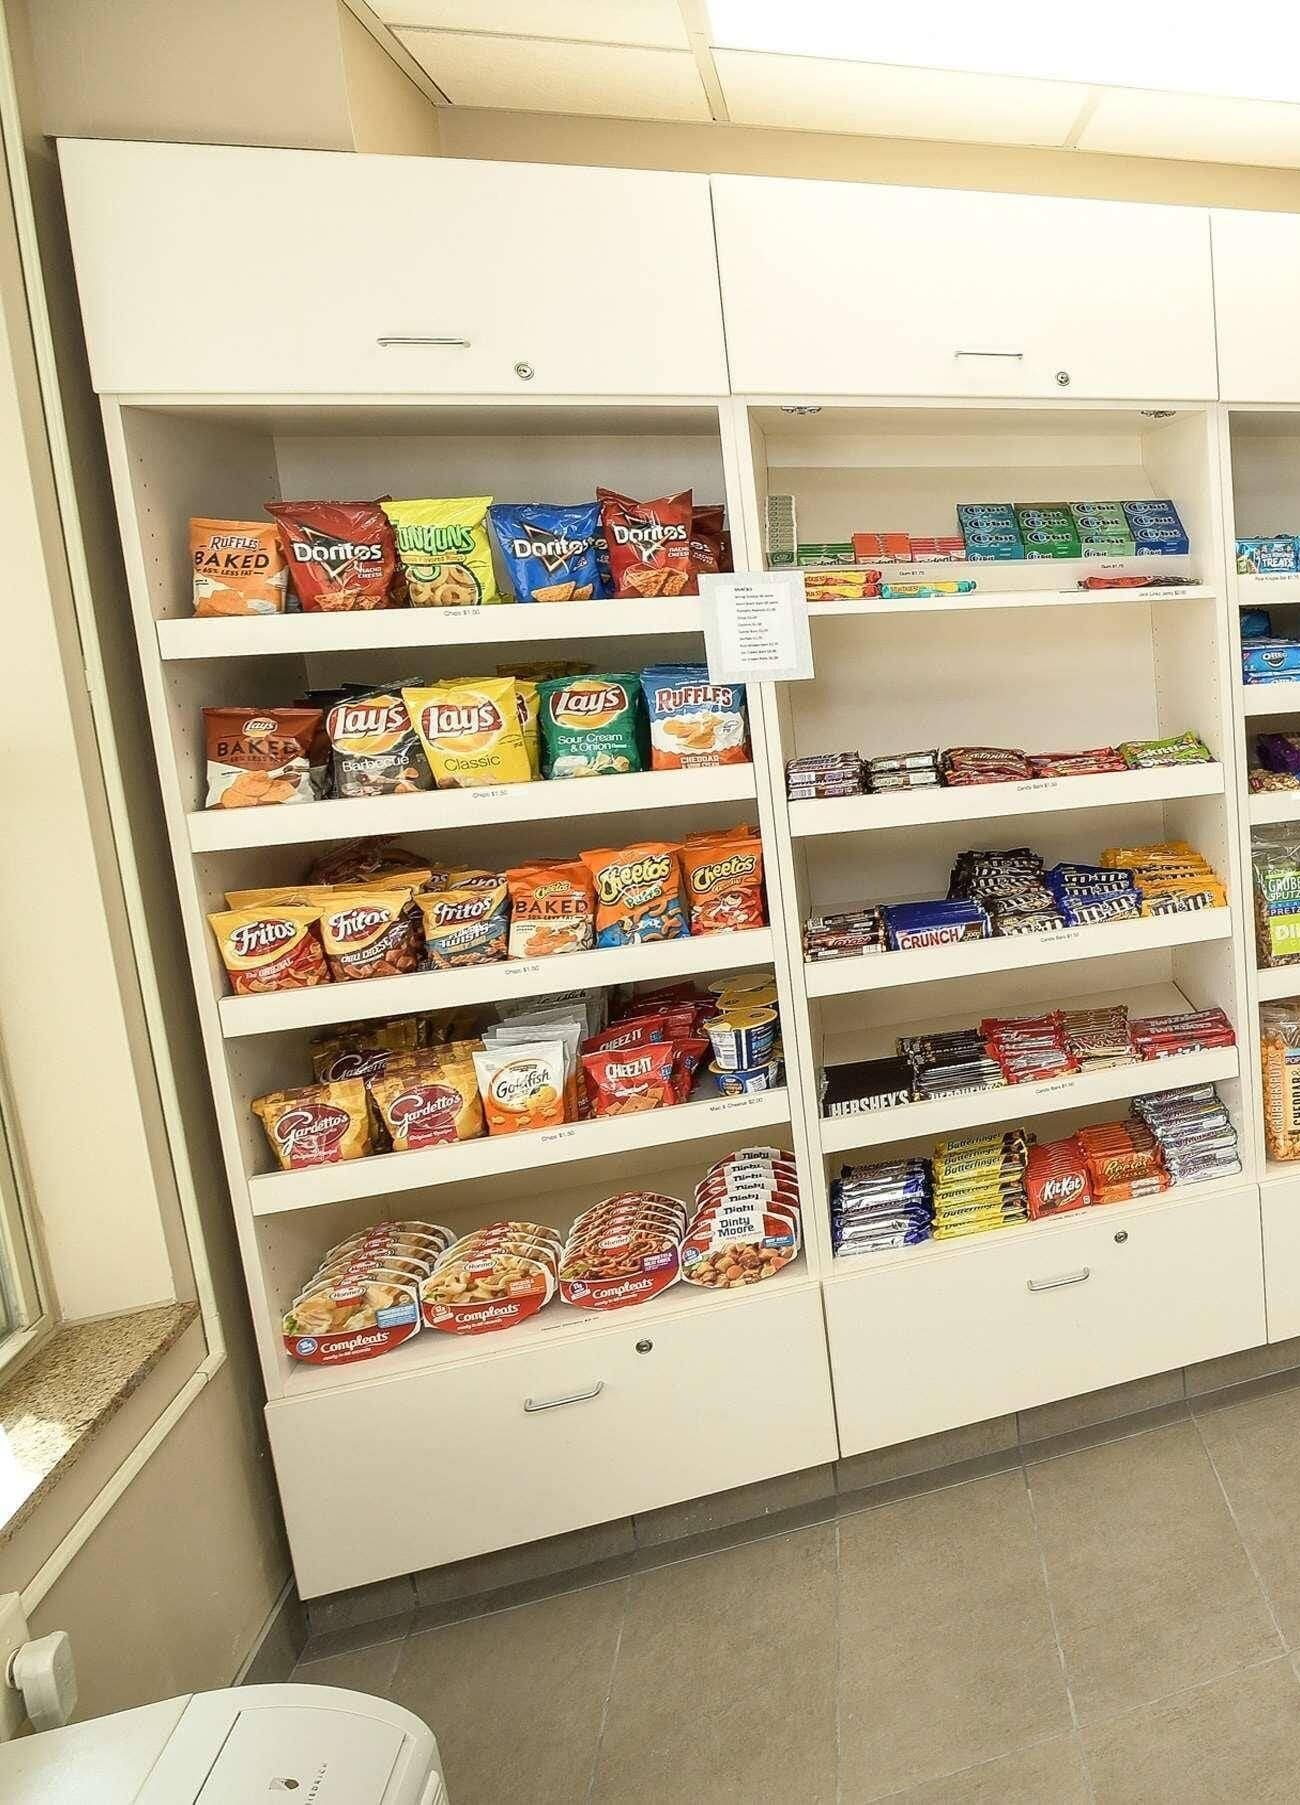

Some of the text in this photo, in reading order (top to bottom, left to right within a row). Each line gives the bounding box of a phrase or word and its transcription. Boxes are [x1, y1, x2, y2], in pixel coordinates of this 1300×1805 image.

[210, 535, 259, 550] RUFFLES
[391, 524, 475, 556] UNYUNS
[613, 525, 687, 544] Doritos
[293, 542, 382, 562] Doritos
[514, 539, 588, 559] Doritos
[194, 551, 270, 569] BAKED
[657, 686, 732, 712] RUFFLES
[217, 738, 298, 756] BAKED
[558, 733, 623, 744] Sour Cream
[570, 742, 612, 752] & Onion
[342, 755, 410, 773] Barbecue
[444, 755, 501, 772] Classic
[600, 856, 670, 903] Cheetos
[692, 857, 754, 891] Cheetos
[433, 897, 492, 926] Fritos
[515, 901, 588, 914] BAKED
[232, 920, 296, 957] Fritos
[901, 929, 959, 950] CRUNCH
[605, 1057, 652, 1080] CHEEZ-IT
[496, 1068, 551, 1098] Goldfish
[829, 1091, 910, 1117] HERSHEY'S
[388, 1093, 461, 1138] Gardetto's
[275, 1111, 349, 1157] Gardetto's
[717, 1225, 755, 1237] Moore
[719, 1217, 750, 1229] Dinty
[592, 1278, 654, 1299] Compleats
[455, 1304, 520, 1323] Compleats
[321, 1331, 390, 1353] Compleats
